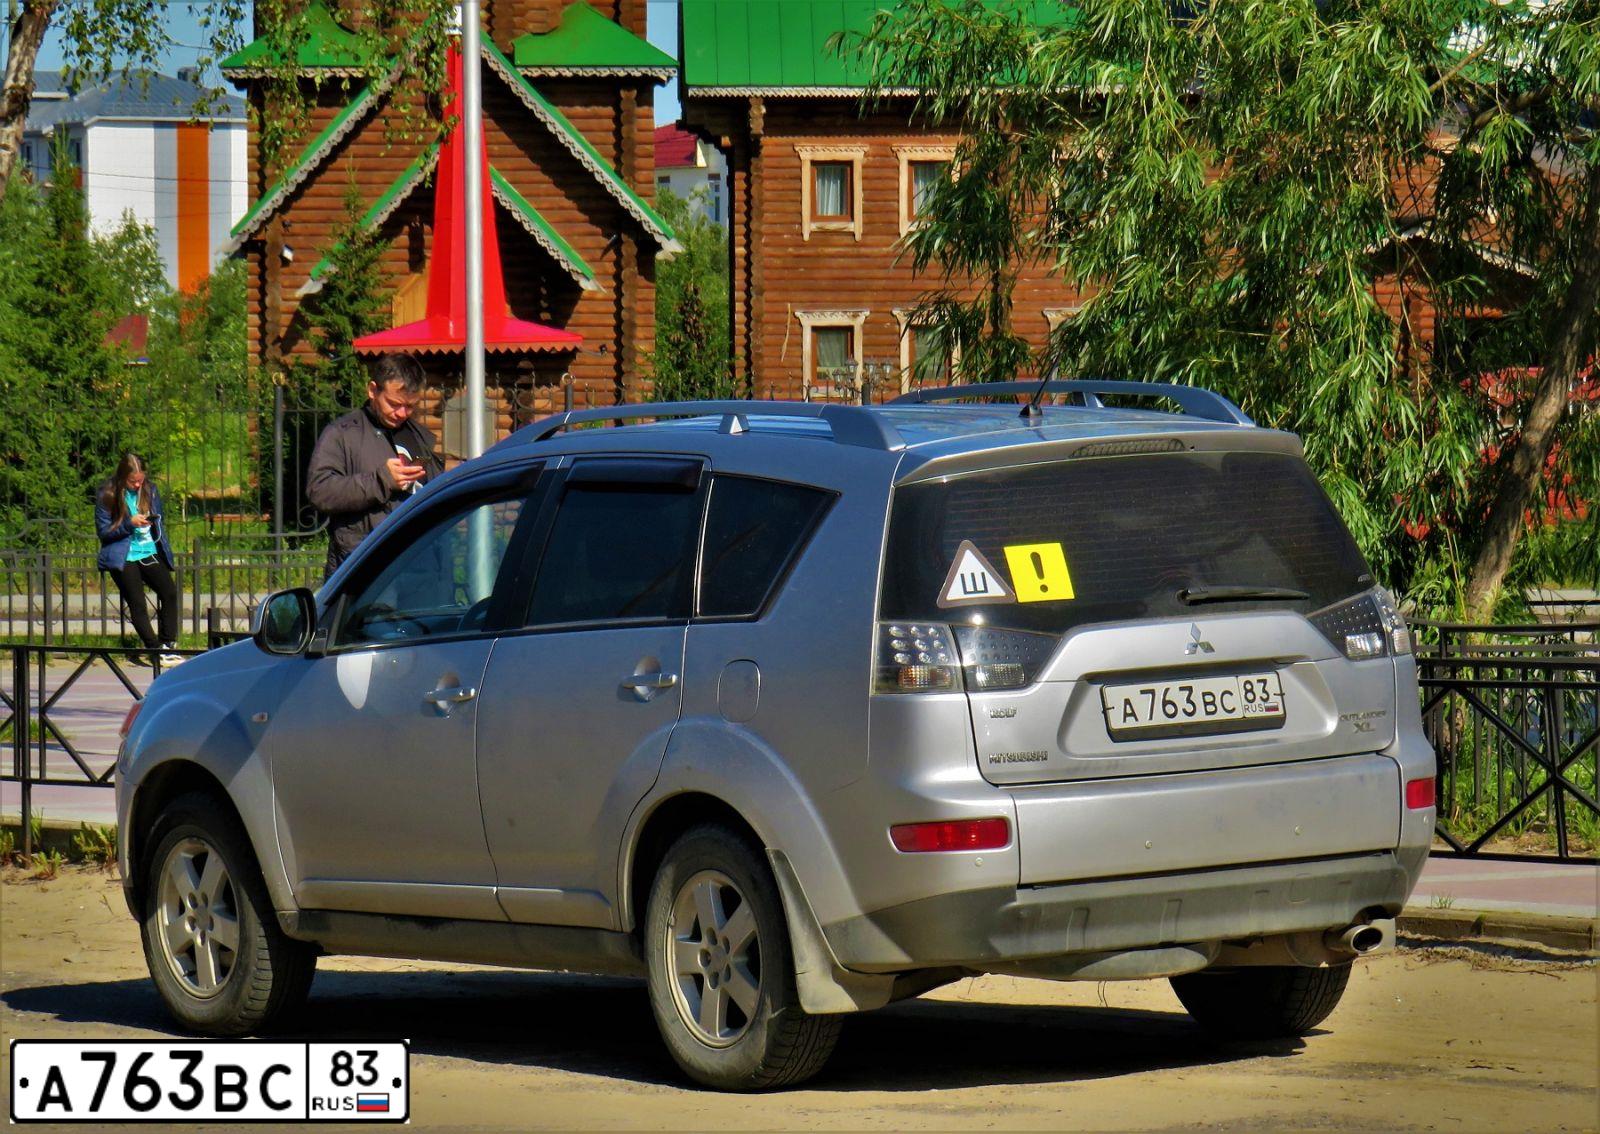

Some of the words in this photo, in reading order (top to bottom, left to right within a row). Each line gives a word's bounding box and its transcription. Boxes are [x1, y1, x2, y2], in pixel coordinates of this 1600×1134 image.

[960, 571, 989, 595] Ш
[1122, 685, 1236, 723] A763BC
[1243, 679, 1270, 703] 83
[1244, 703, 1264, 713] RUS
